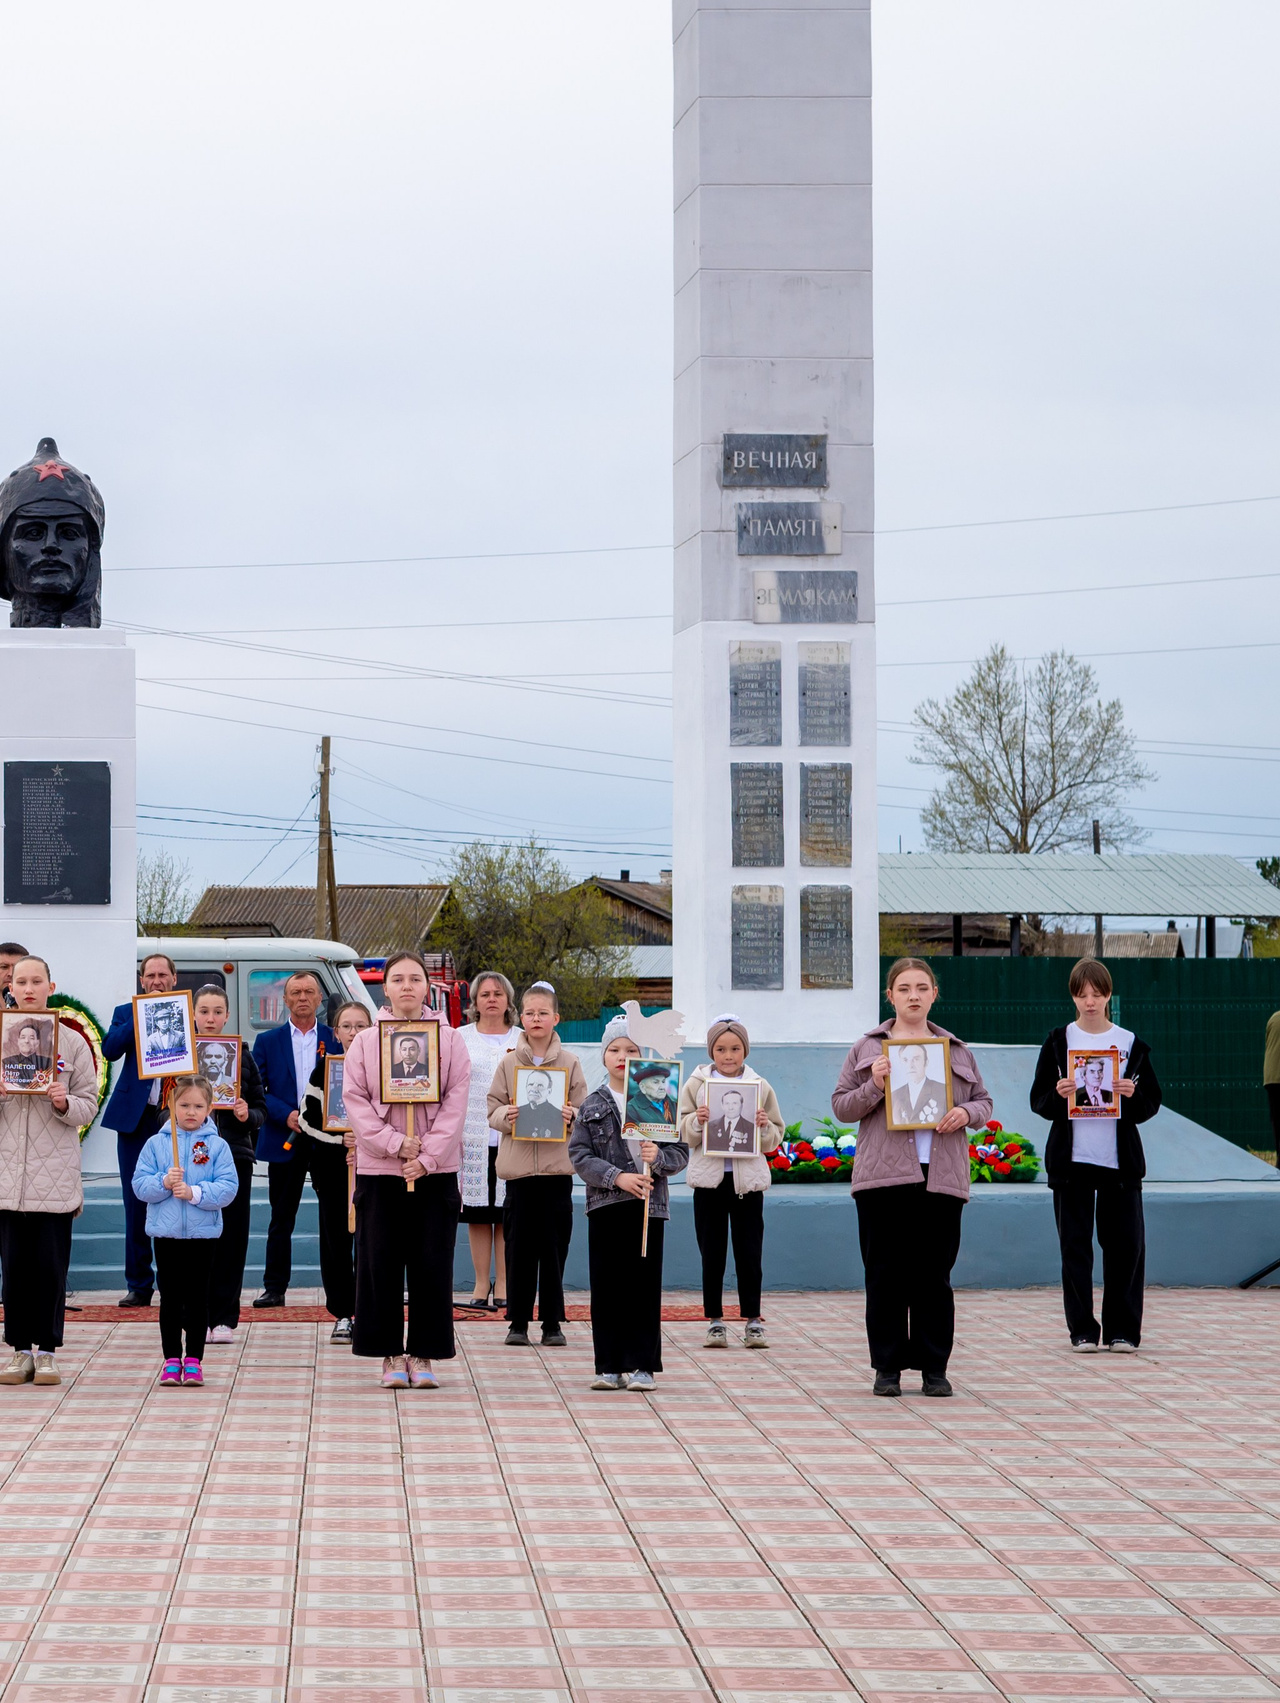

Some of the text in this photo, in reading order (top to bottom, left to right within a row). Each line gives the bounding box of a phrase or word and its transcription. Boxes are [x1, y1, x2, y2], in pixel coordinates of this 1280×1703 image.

[733, 451, 817, 468] ВЕЧНАЯ
[749, 519, 832, 536] ПАМЯТЬ
[757, 588, 857, 606] ЗЕМЛЯКАМ
